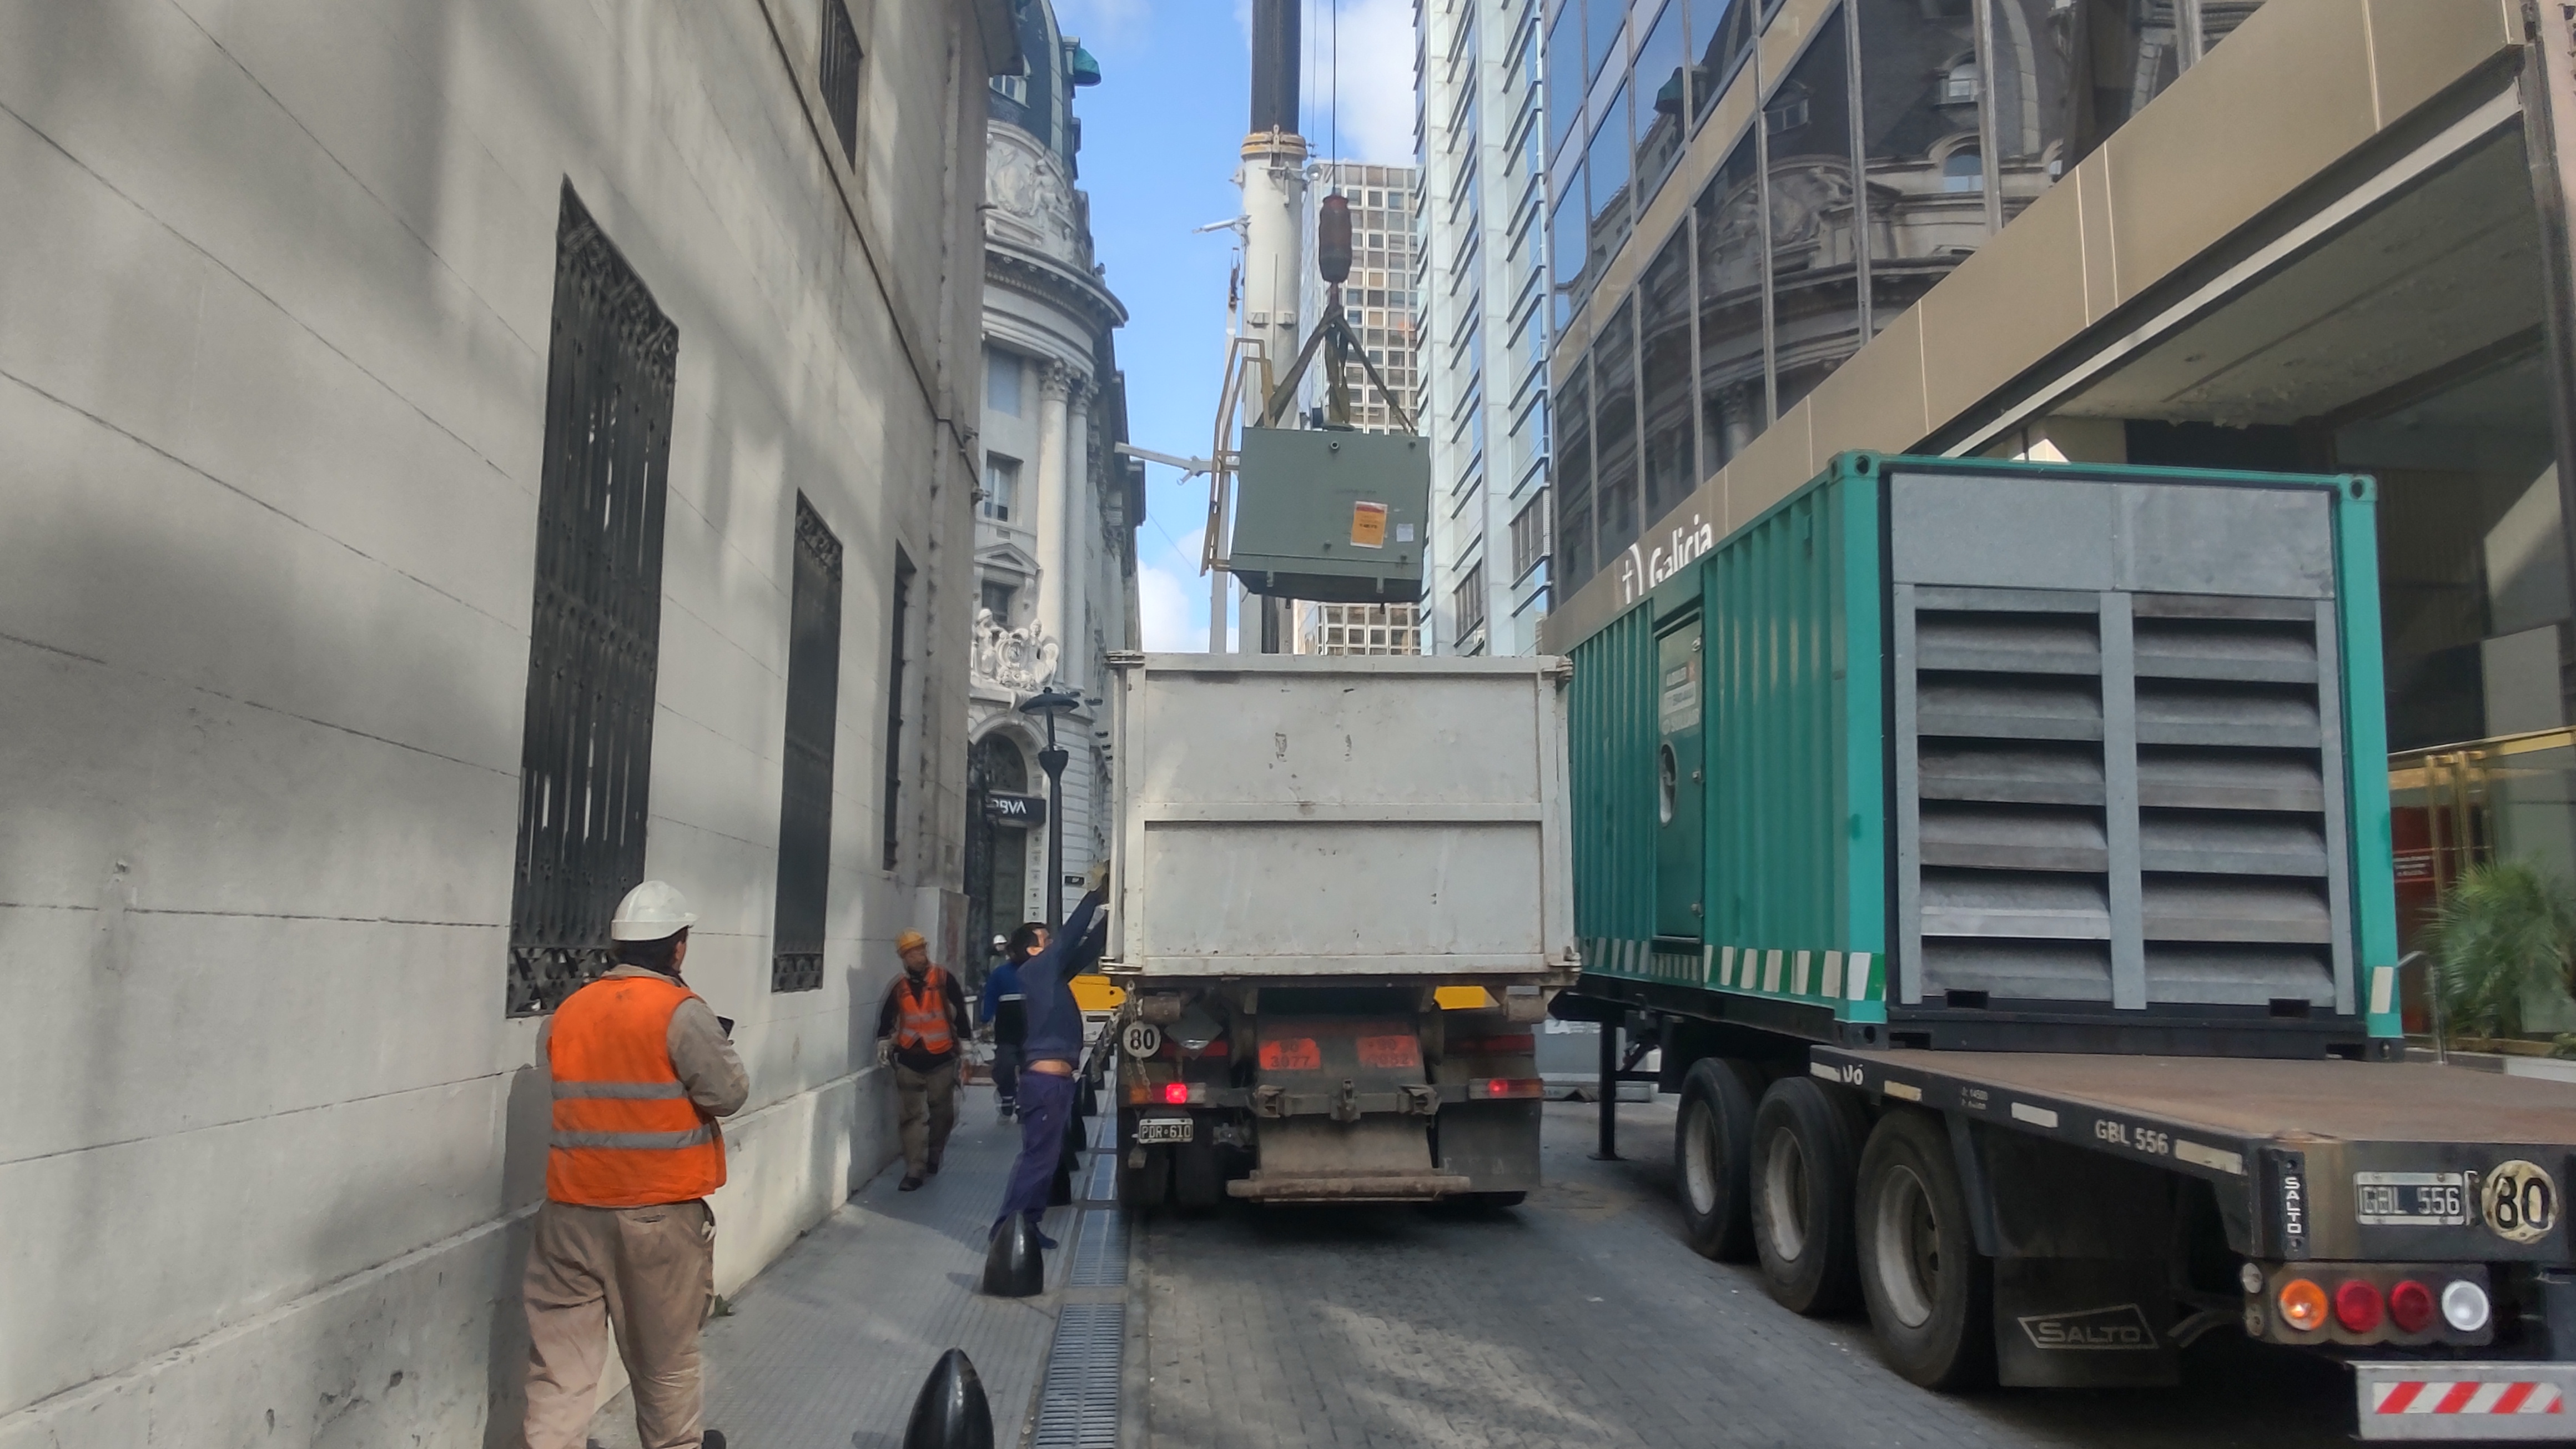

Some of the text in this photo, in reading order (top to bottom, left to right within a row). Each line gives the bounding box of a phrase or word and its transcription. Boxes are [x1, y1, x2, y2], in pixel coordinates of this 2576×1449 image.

[1649, 514, 1712, 588] Galicia
[1130, 1028, 1155, 1050] 80
[1141, 1125, 1191, 1138] PDR 610
[2096, 1119, 2169, 1155] GBL 556
[2285, 1176, 2302, 1234] SALTO
[2362, 1186, 2460, 1215] GBL 556
[2496, 1176, 2552, 1230] 80
[2037, 1322, 2140, 1343] SALTO
